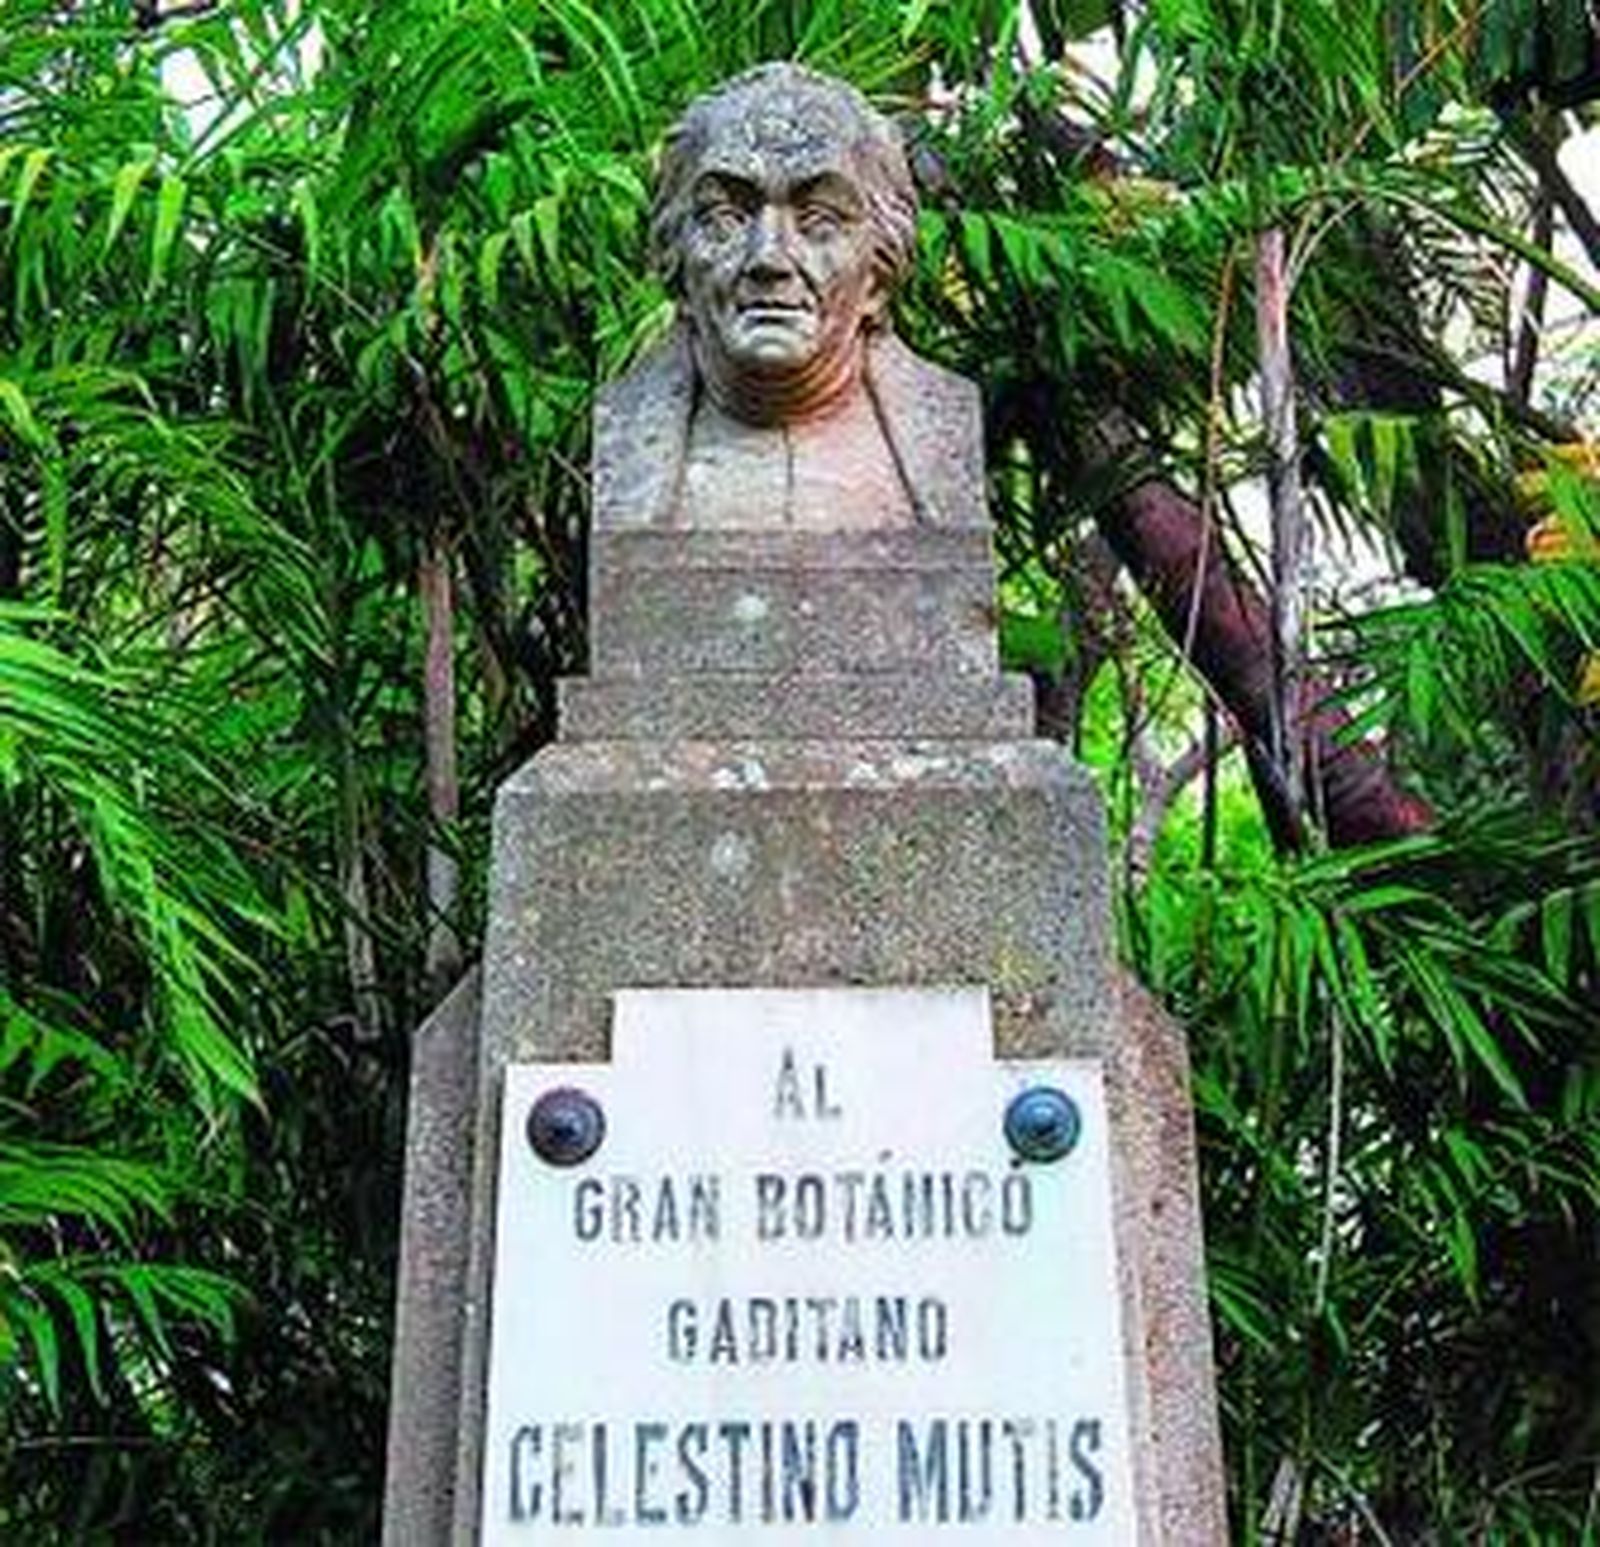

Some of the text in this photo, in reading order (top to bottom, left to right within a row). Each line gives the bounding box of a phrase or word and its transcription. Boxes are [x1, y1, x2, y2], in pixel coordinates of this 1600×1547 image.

[772, 1046, 843, 1120] AL
[574, 1173, 721, 1243] GRAN
[667, 1296, 949, 1364] GADITANO
[508, 1418, 1105, 1526] CELESTINO MUTIS
